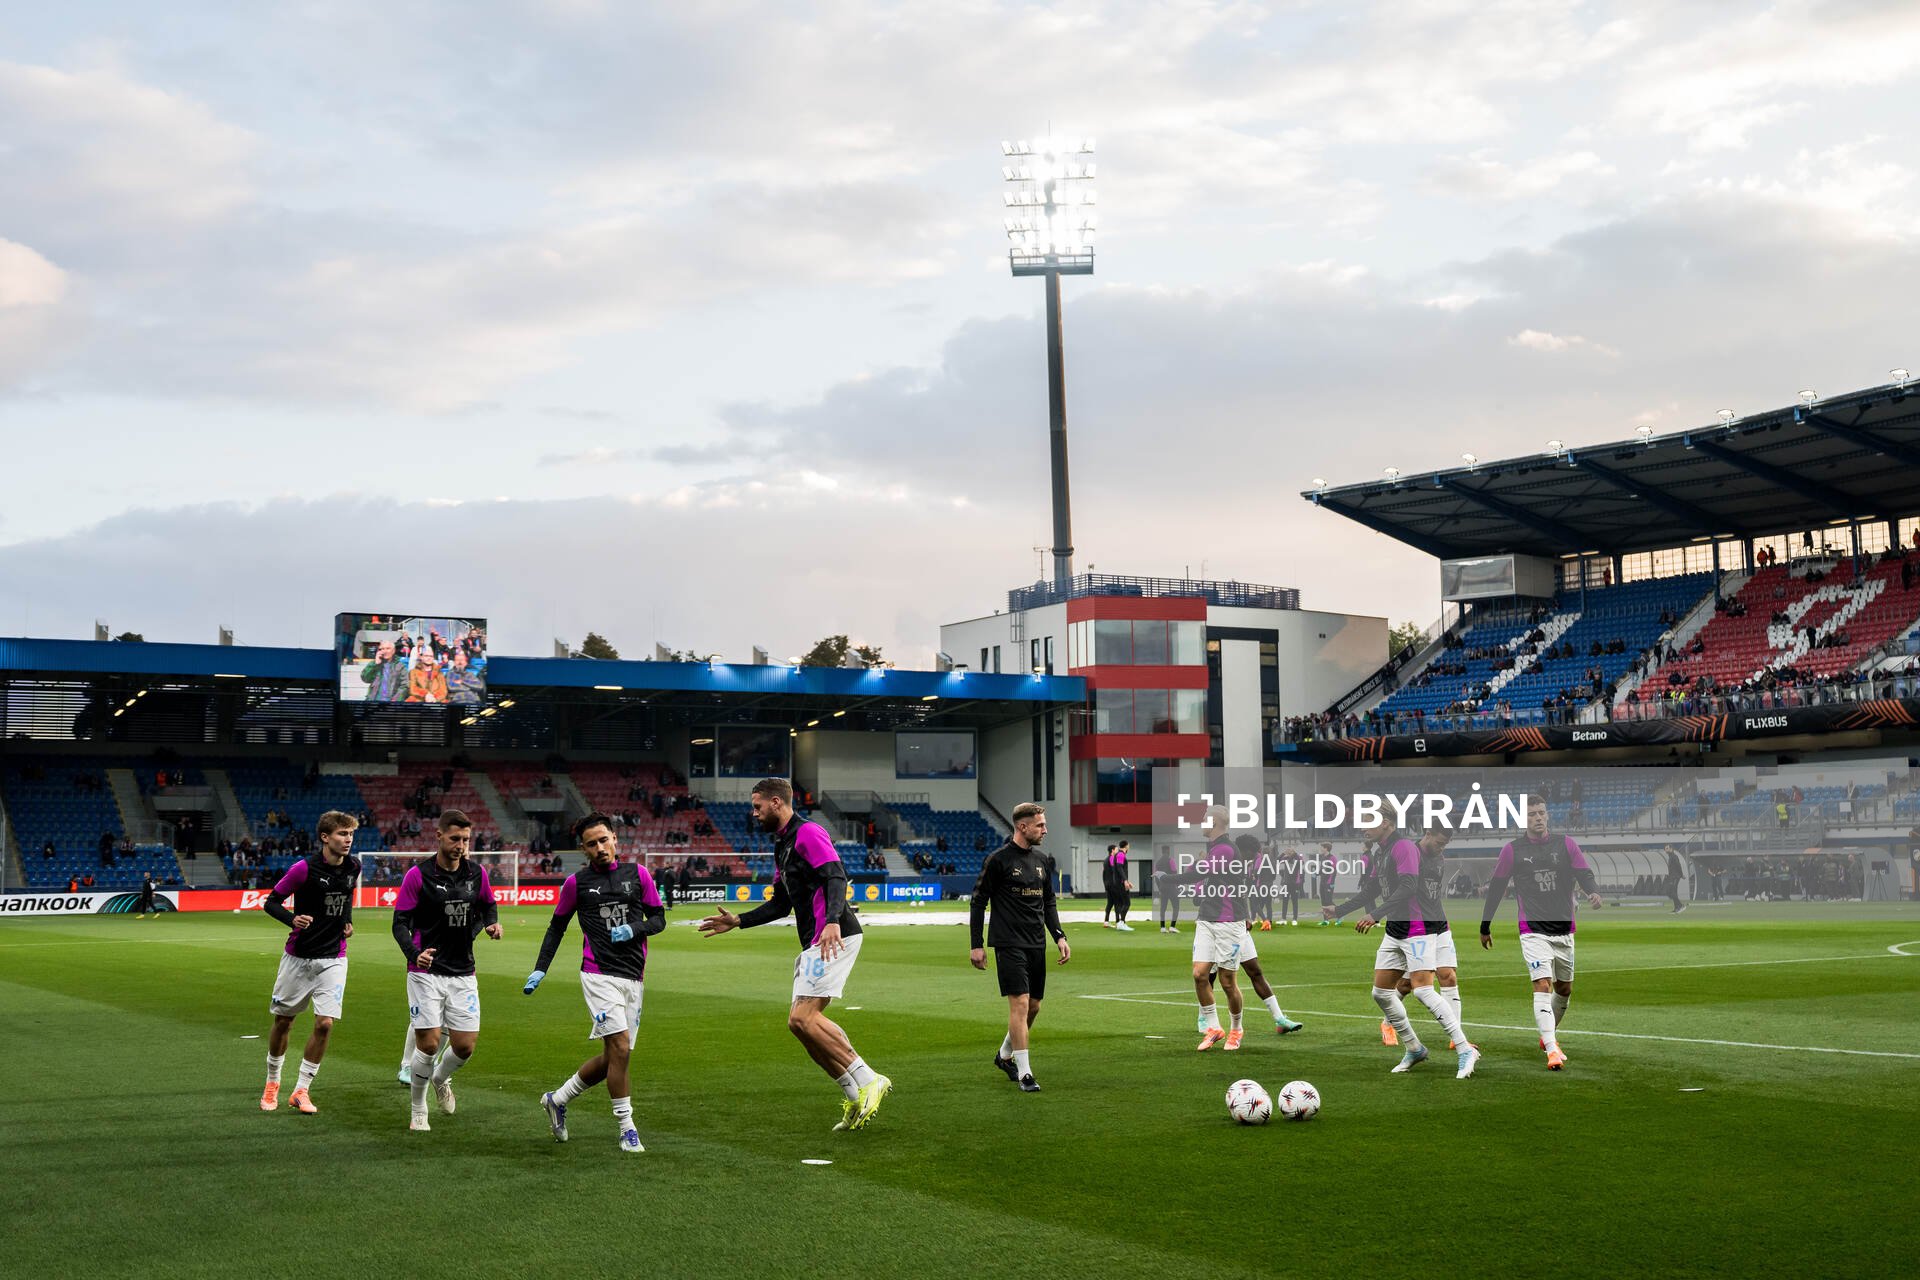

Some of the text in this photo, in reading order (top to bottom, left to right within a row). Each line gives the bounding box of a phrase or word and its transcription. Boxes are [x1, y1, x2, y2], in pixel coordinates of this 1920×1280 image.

[1572, 731, 1608, 741] Betano
[493, 889, 554, 902] STRAUSS
[672, 887, 725, 901] terprise
[892, 886, 934, 897] RECYCLE
[1410, 941, 1426, 958] 17
[804, 956, 825, 977] 18
